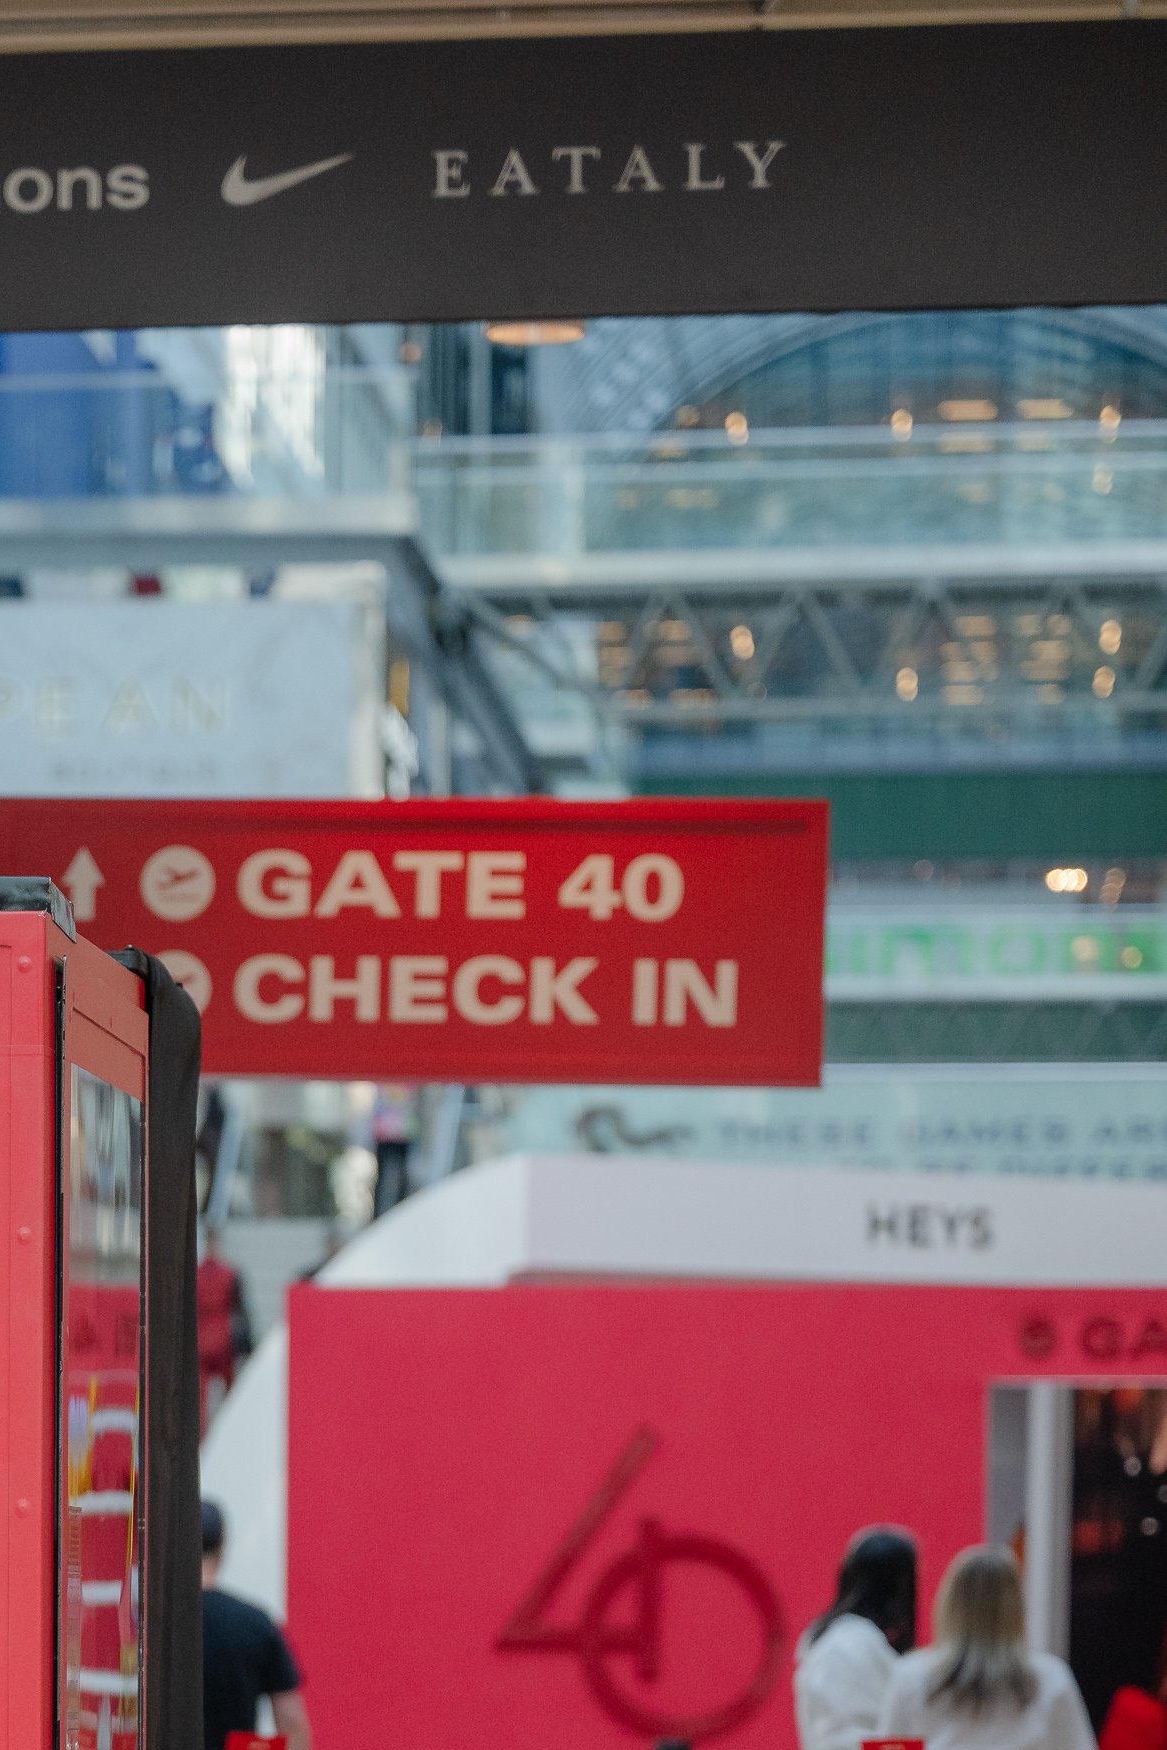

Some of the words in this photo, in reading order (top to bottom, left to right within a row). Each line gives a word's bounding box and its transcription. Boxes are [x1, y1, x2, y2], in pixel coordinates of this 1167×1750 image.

[432, 139, 787, 199] EATALY
[236, 847, 528, 921] GATE
[556, 852, 686, 924] 40
[232, 952, 600, 1027] CHECK
[630, 956, 740, 1030] IN
[865, 1203, 995, 1252] HEYS
